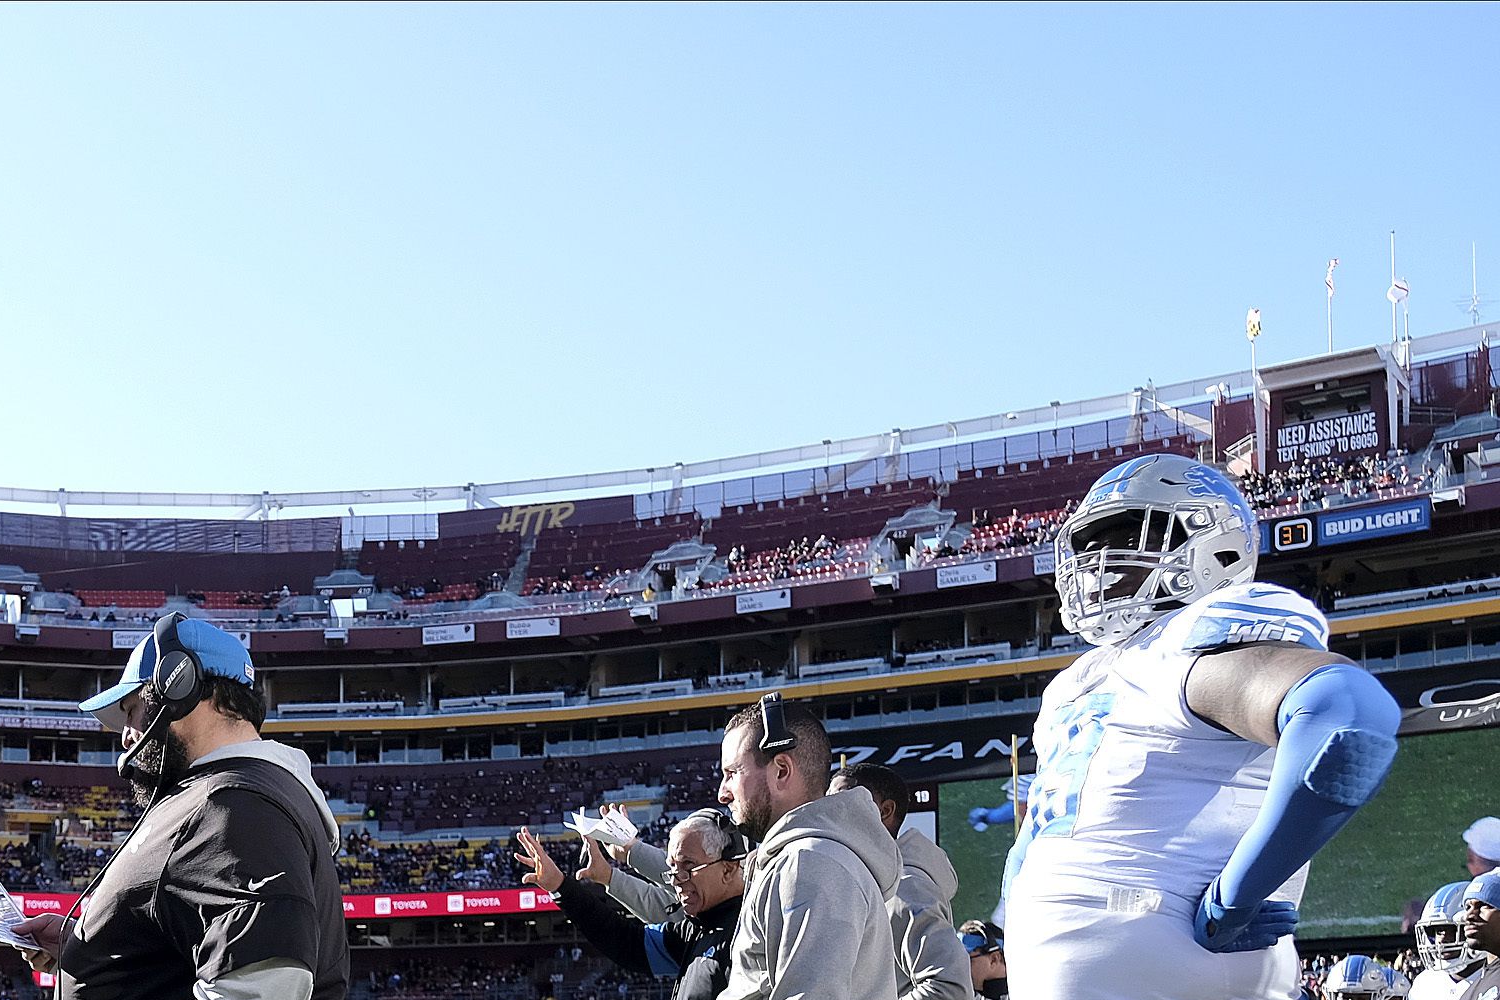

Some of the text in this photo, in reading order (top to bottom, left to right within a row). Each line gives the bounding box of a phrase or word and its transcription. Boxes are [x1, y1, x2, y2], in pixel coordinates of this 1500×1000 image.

[1277, 412, 1376, 446] NEED ASSISTANCE
[1277, 445, 1299, 463] TEXT
[1337, 437, 1349, 452] TO
[1350, 432, 1379, 451] 69050
[497, 502, 575, 535] HTTR
[1325, 508, 1421, 537] BUD LIGHT
[1282, 525, 1306, 545] 37
[1227, 620, 1304, 644] WCF
[164, 659, 190, 688] BOSE
[22, 899, 61, 910] TOYOTA
[389, 900, 428, 910] TOYOTA
[462, 897, 501, 908] TOYOTA
